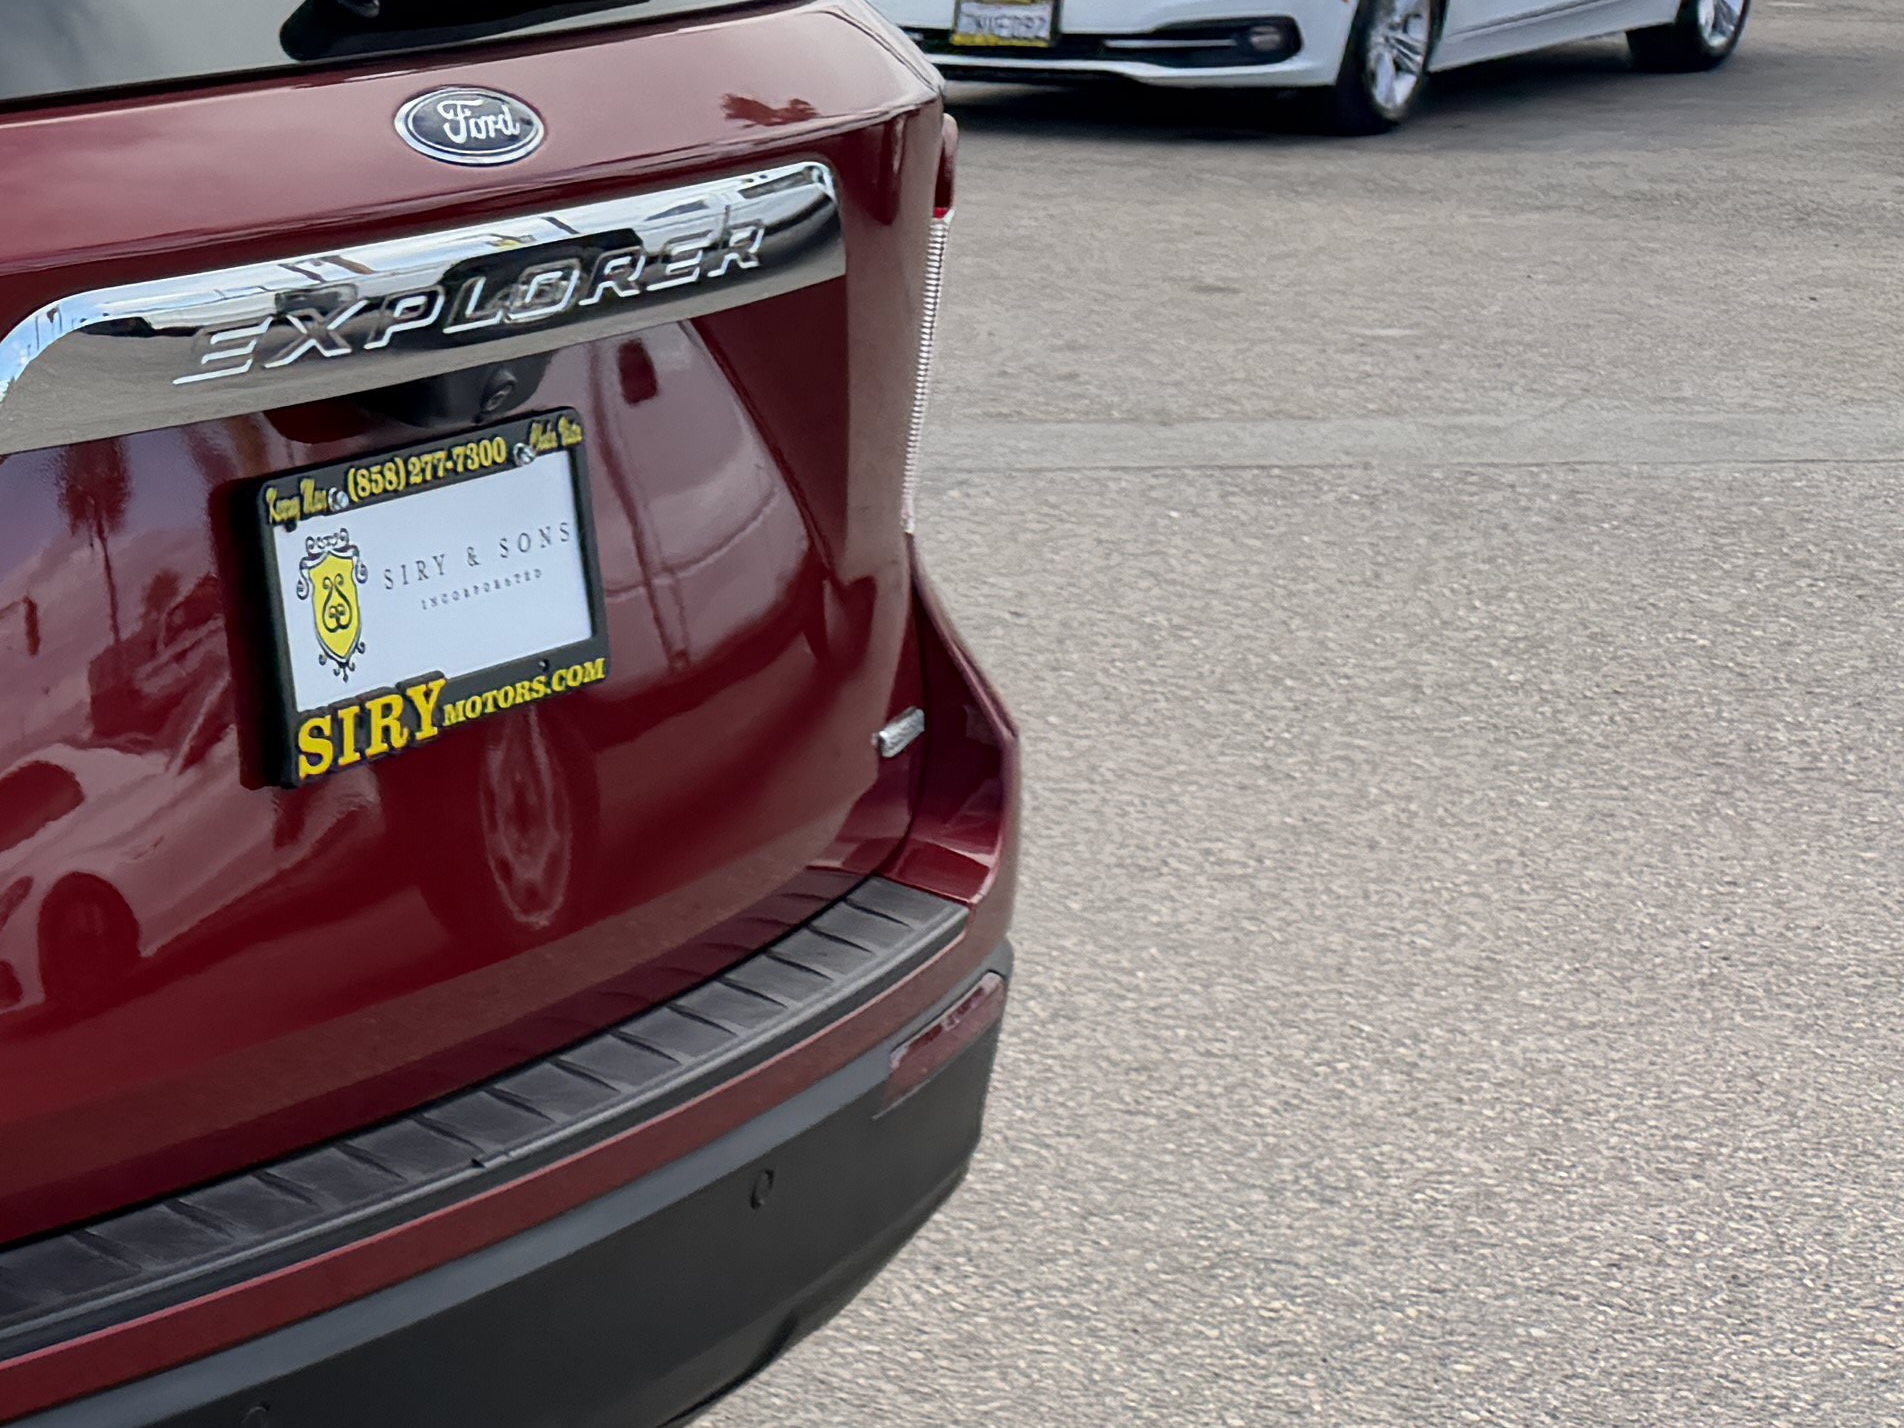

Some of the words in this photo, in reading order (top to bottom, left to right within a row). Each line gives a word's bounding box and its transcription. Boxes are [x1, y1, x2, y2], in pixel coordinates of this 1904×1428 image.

[436, 98, 521, 144] Ford
[172, 217, 767, 386] EXPLORER
[346, 457, 407, 503] (858)
[407, 436, 508, 486] 277-7300
[383, 552, 448, 590] SIRY
[465, 545, 482, 568] &
[499, 520, 572, 559] SONS
